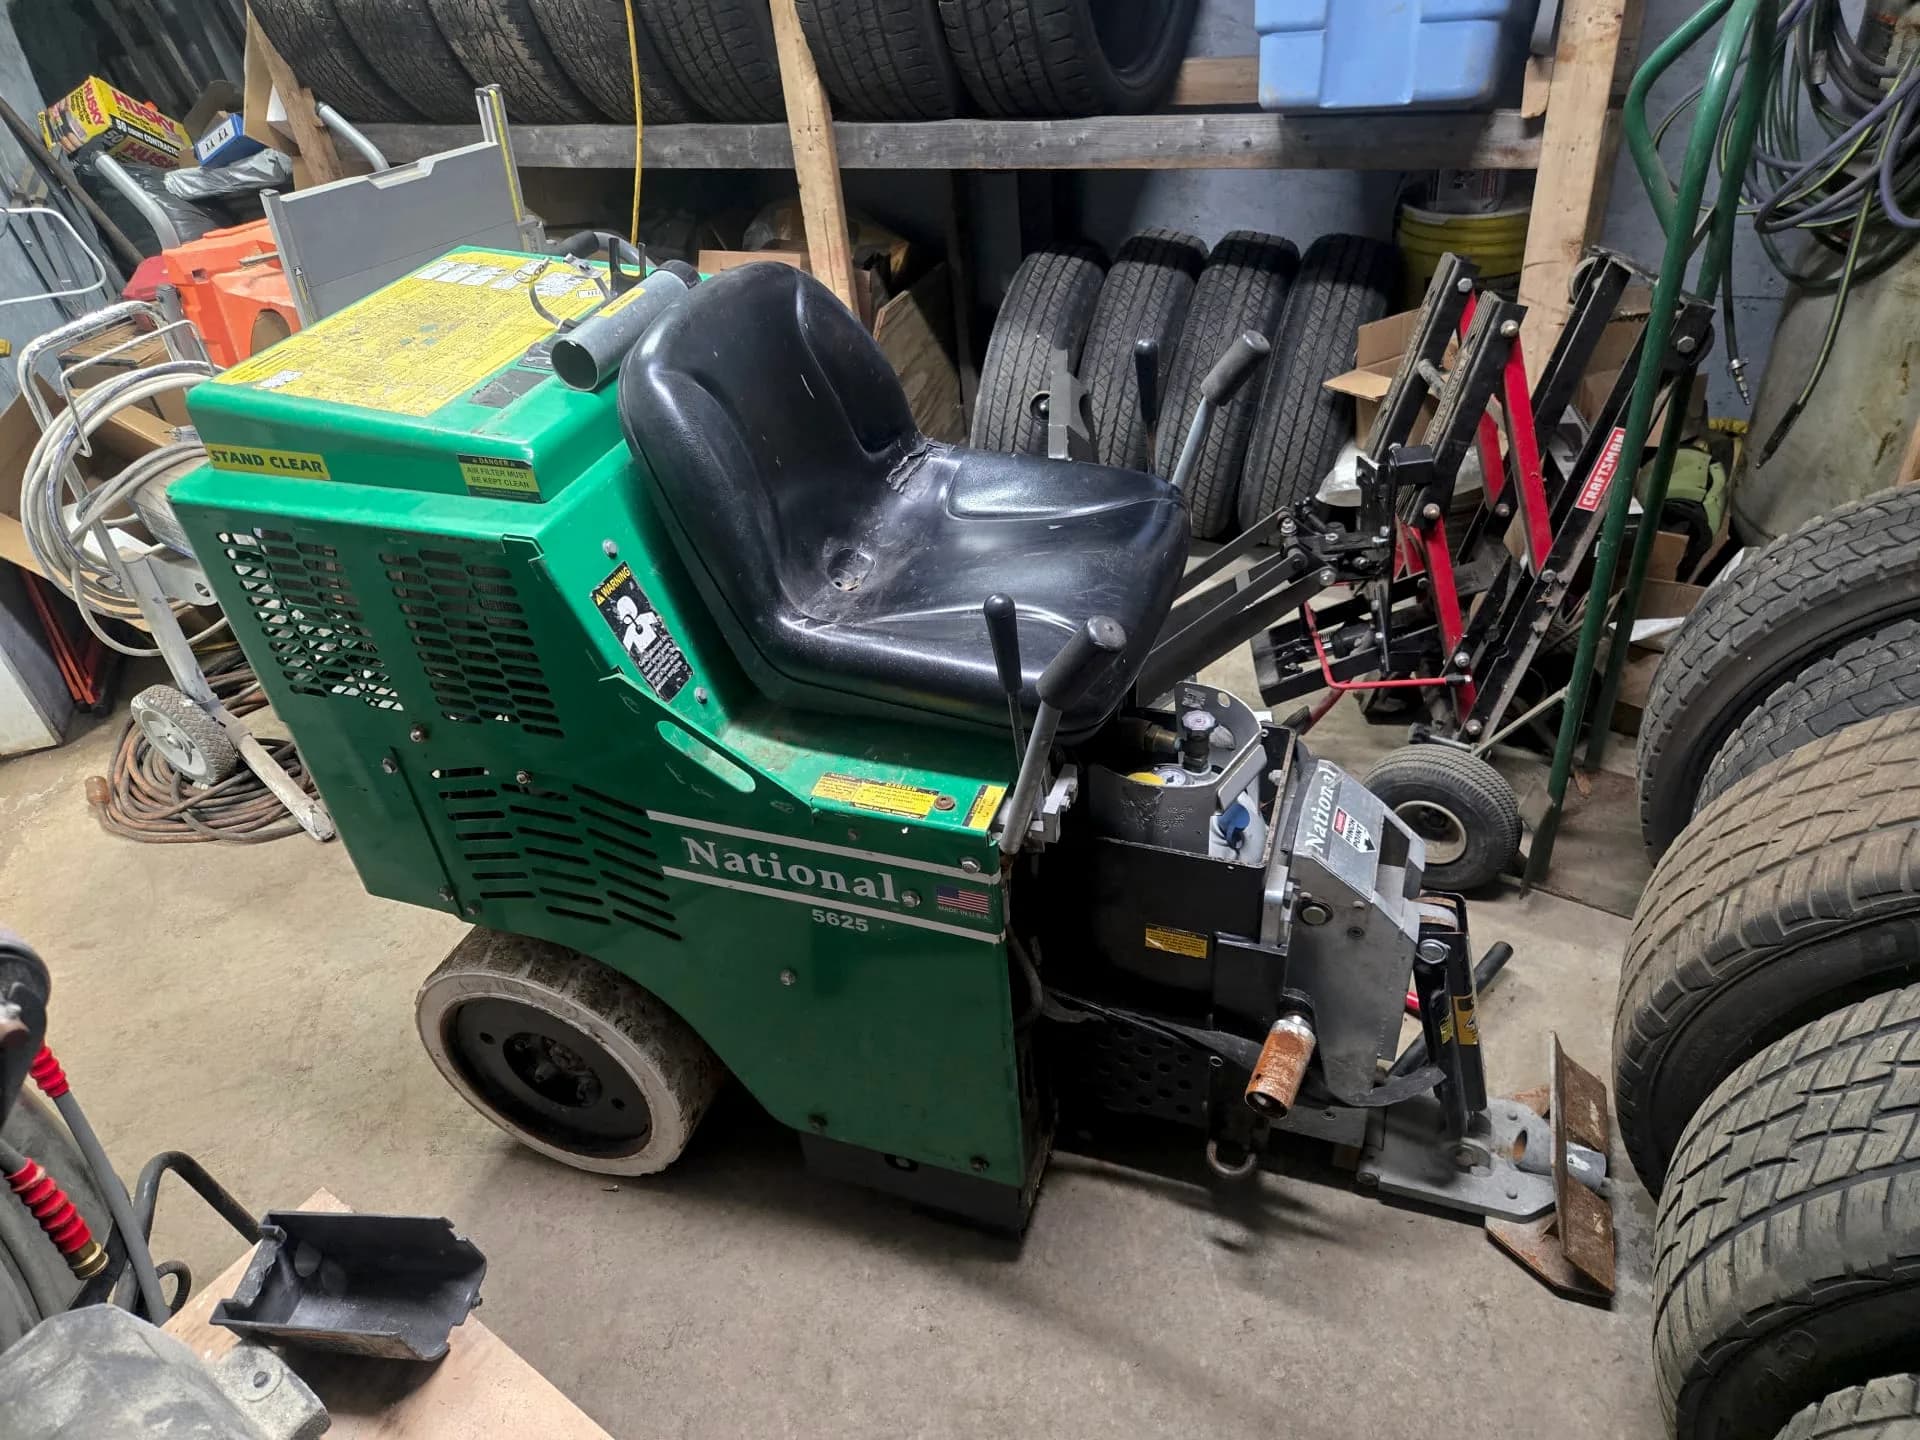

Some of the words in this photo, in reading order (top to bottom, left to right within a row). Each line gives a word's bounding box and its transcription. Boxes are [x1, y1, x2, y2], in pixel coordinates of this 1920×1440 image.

[84, 81, 106, 126] HUSKY
[112, 91, 175, 133] HUSKY
[211, 450, 265, 467] STAND
[269, 456, 324, 473] CLEAR
[478, 457, 509, 467] DANGER
[480, 467, 506, 477] FILTER
[507, 470, 528, 480] MUST
[504, 479, 530, 489] CLEAN
[600, 566, 631, 598] WARNING
[1304, 766, 1337, 854] National
[1345, 818, 1357, 843] PINCH
[1353, 823, 1365, 848] POINT
[681, 836, 899, 904] National
[812, 909, 870, 933] 5625
